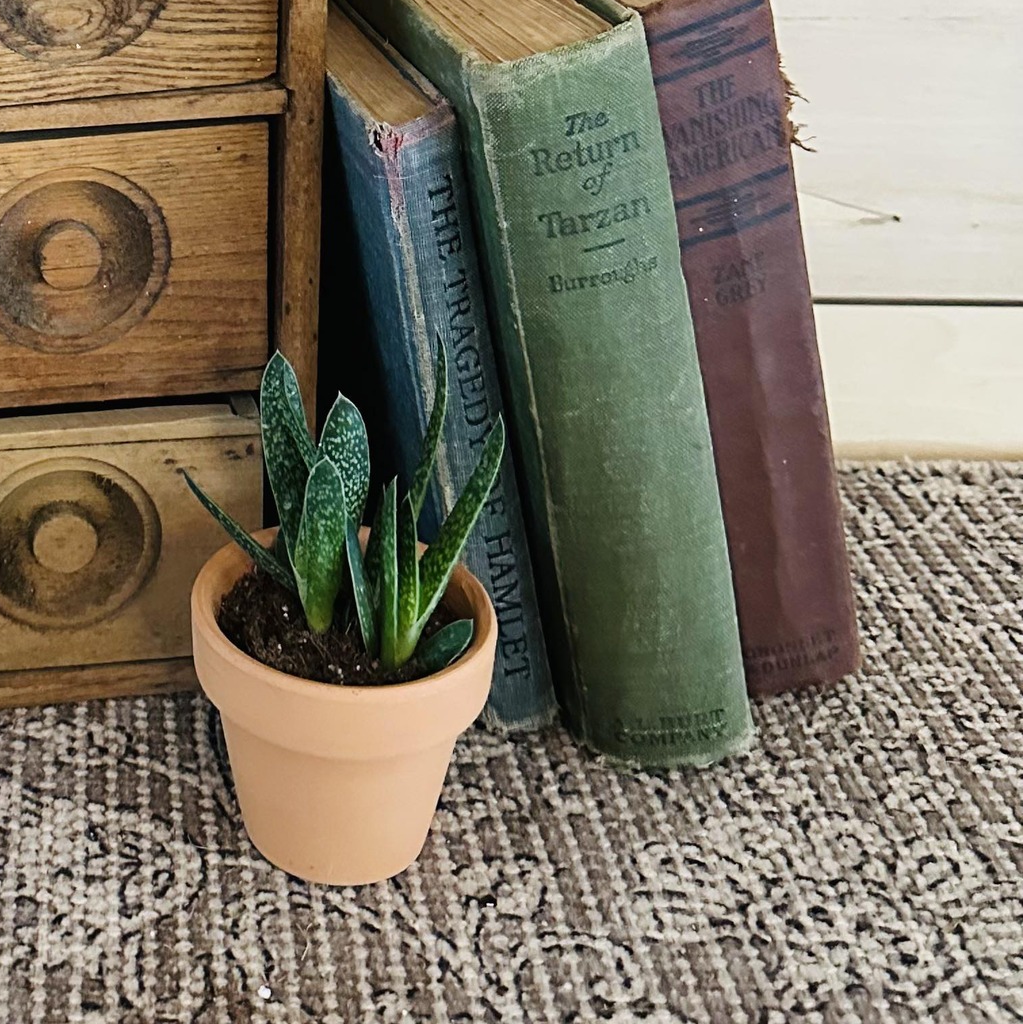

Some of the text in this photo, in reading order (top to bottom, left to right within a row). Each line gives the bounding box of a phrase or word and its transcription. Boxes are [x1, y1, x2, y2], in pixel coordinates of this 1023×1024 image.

[694, 74, 737, 107] THE
[564, 110, 610, 137] The
[530, 130, 642, 176] Return
[582, 163, 613, 196] of
[428, 174, 462, 262] THE
[537, 195, 652, 239] Tarzan
[548, 255, 658, 294] Burroughs
[715, 272, 767, 307] GREY
[443, 268, 492, 450] TRAGEDY
[483, 529, 530, 679] HAMLET
[613, 721, 728, 745] COMPANY
[658, 707, 726, 731] BURT
